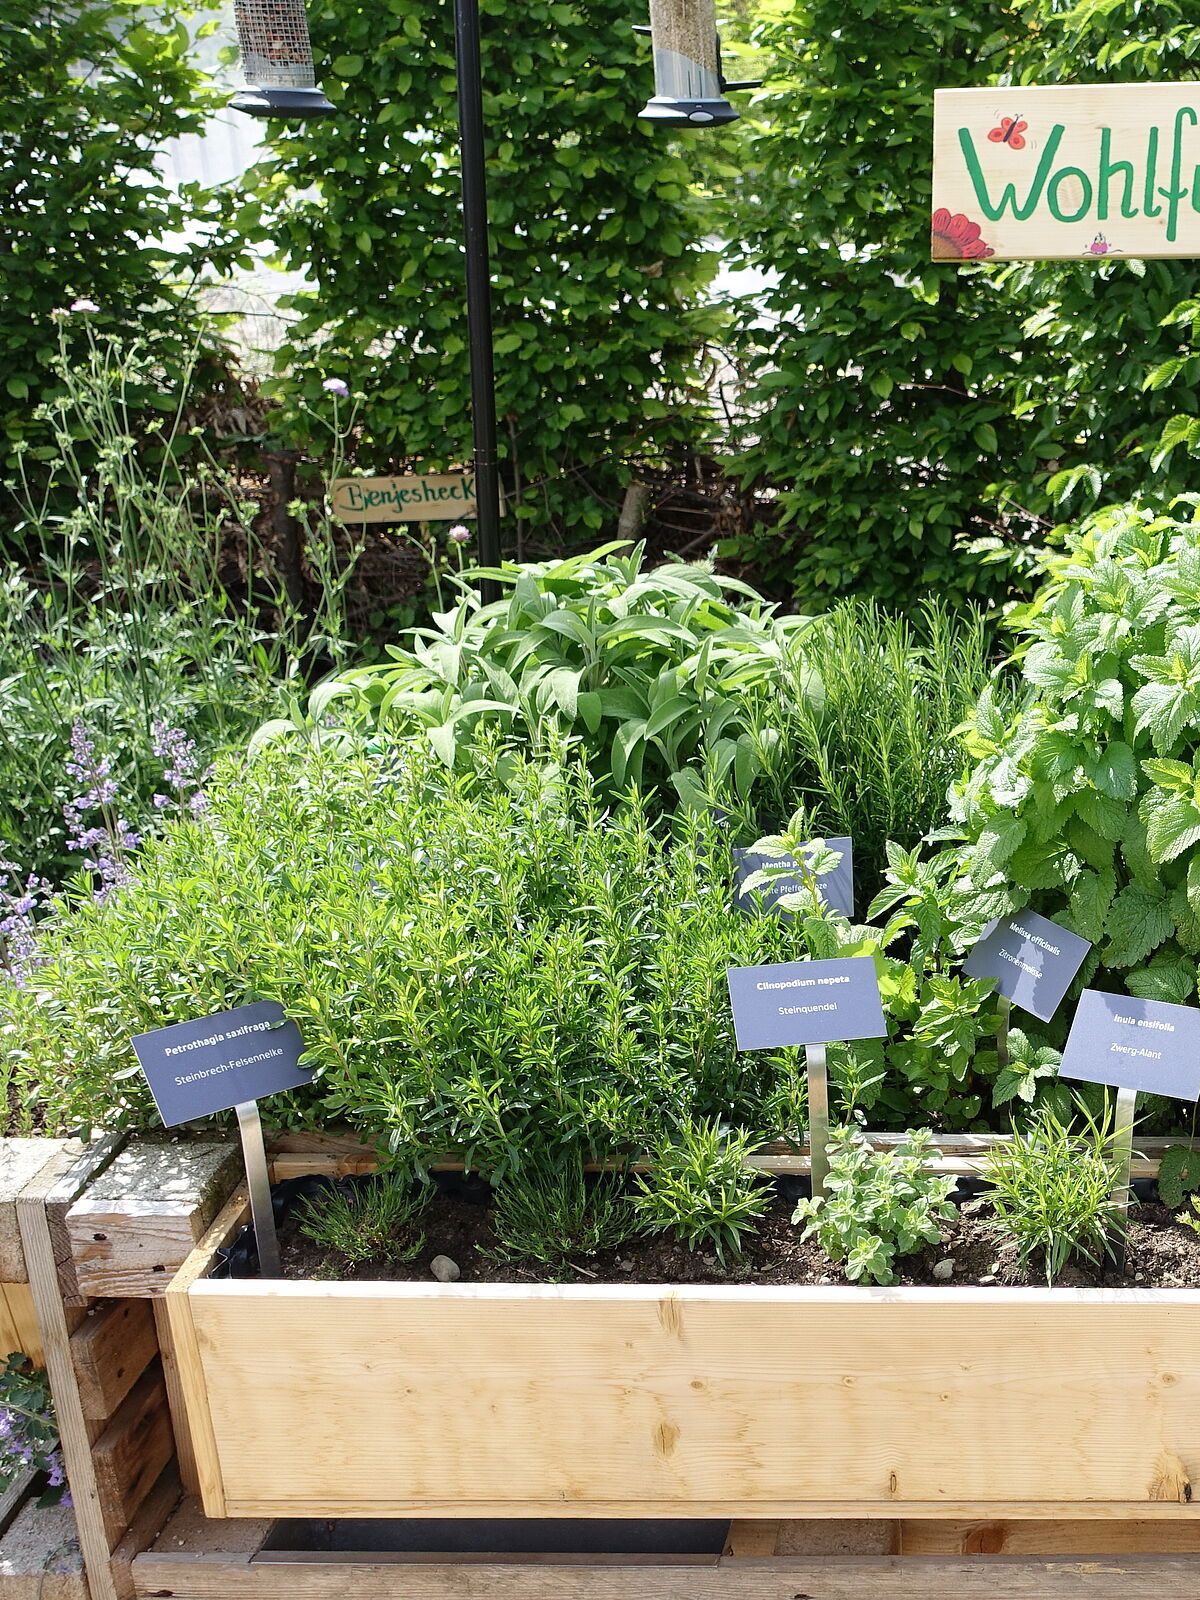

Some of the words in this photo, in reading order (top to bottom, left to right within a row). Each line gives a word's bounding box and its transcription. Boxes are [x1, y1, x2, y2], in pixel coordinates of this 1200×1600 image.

[336, 478, 477, 514] Benjesheck
[1009, 922, 1032, 940] Melissa
[1030, 934, 1061, 956] officinalis
[998, 948, 1043, 979] Zitronenmelisse
[756, 978, 816, 990] Clinopodium
[817, 975, 850, 986] nepeta
[778, 1003, 838, 1015] Steinquendel
[225, 1021, 271, 1039] saxifraga
[1113, 1013, 1136, 1025] Inula
[1137, 1020, 1175, 1032] ensifolia
[1110, 1042, 1162, 1059] Zwerg-Alant
[174, 1047, 284, 1086] Steinbrech-Felsennelke
